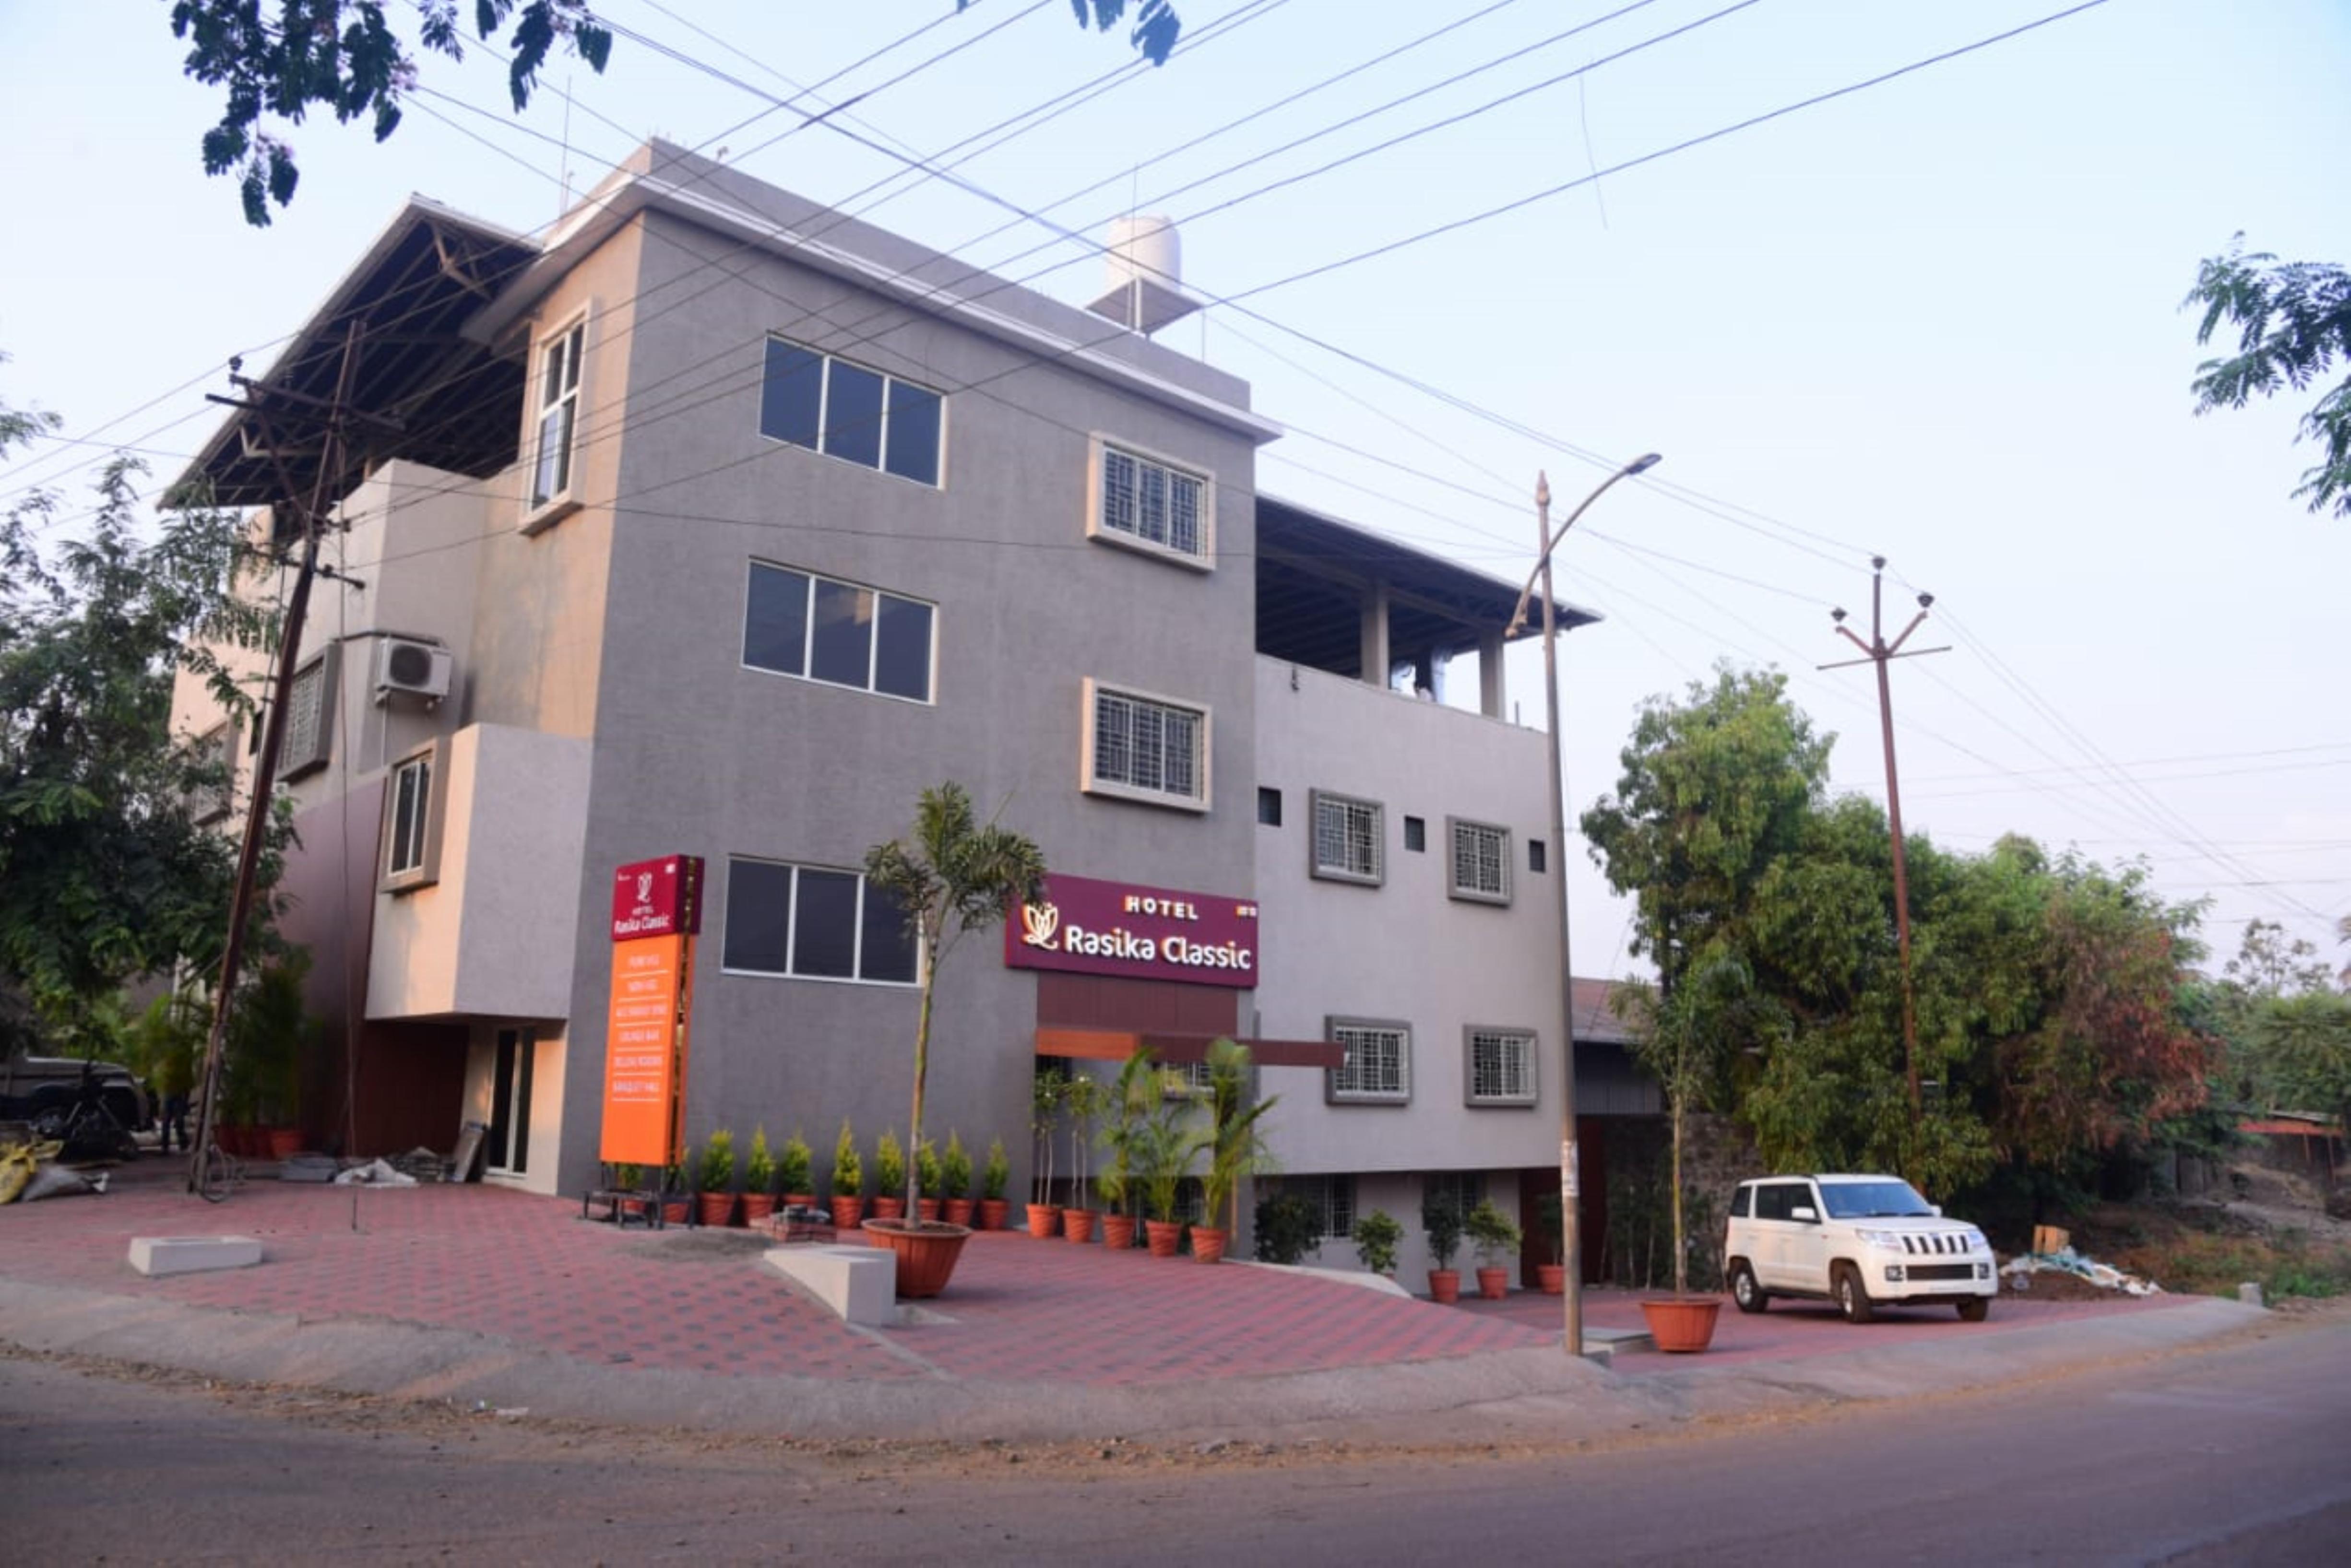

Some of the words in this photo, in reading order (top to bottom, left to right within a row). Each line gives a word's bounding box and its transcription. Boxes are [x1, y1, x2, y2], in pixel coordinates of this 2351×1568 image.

[1123, 894, 1199, 920] HOTEL
[1064, 925, 1155, 961] Rasika
[1160, 936, 1252, 970] Classic
